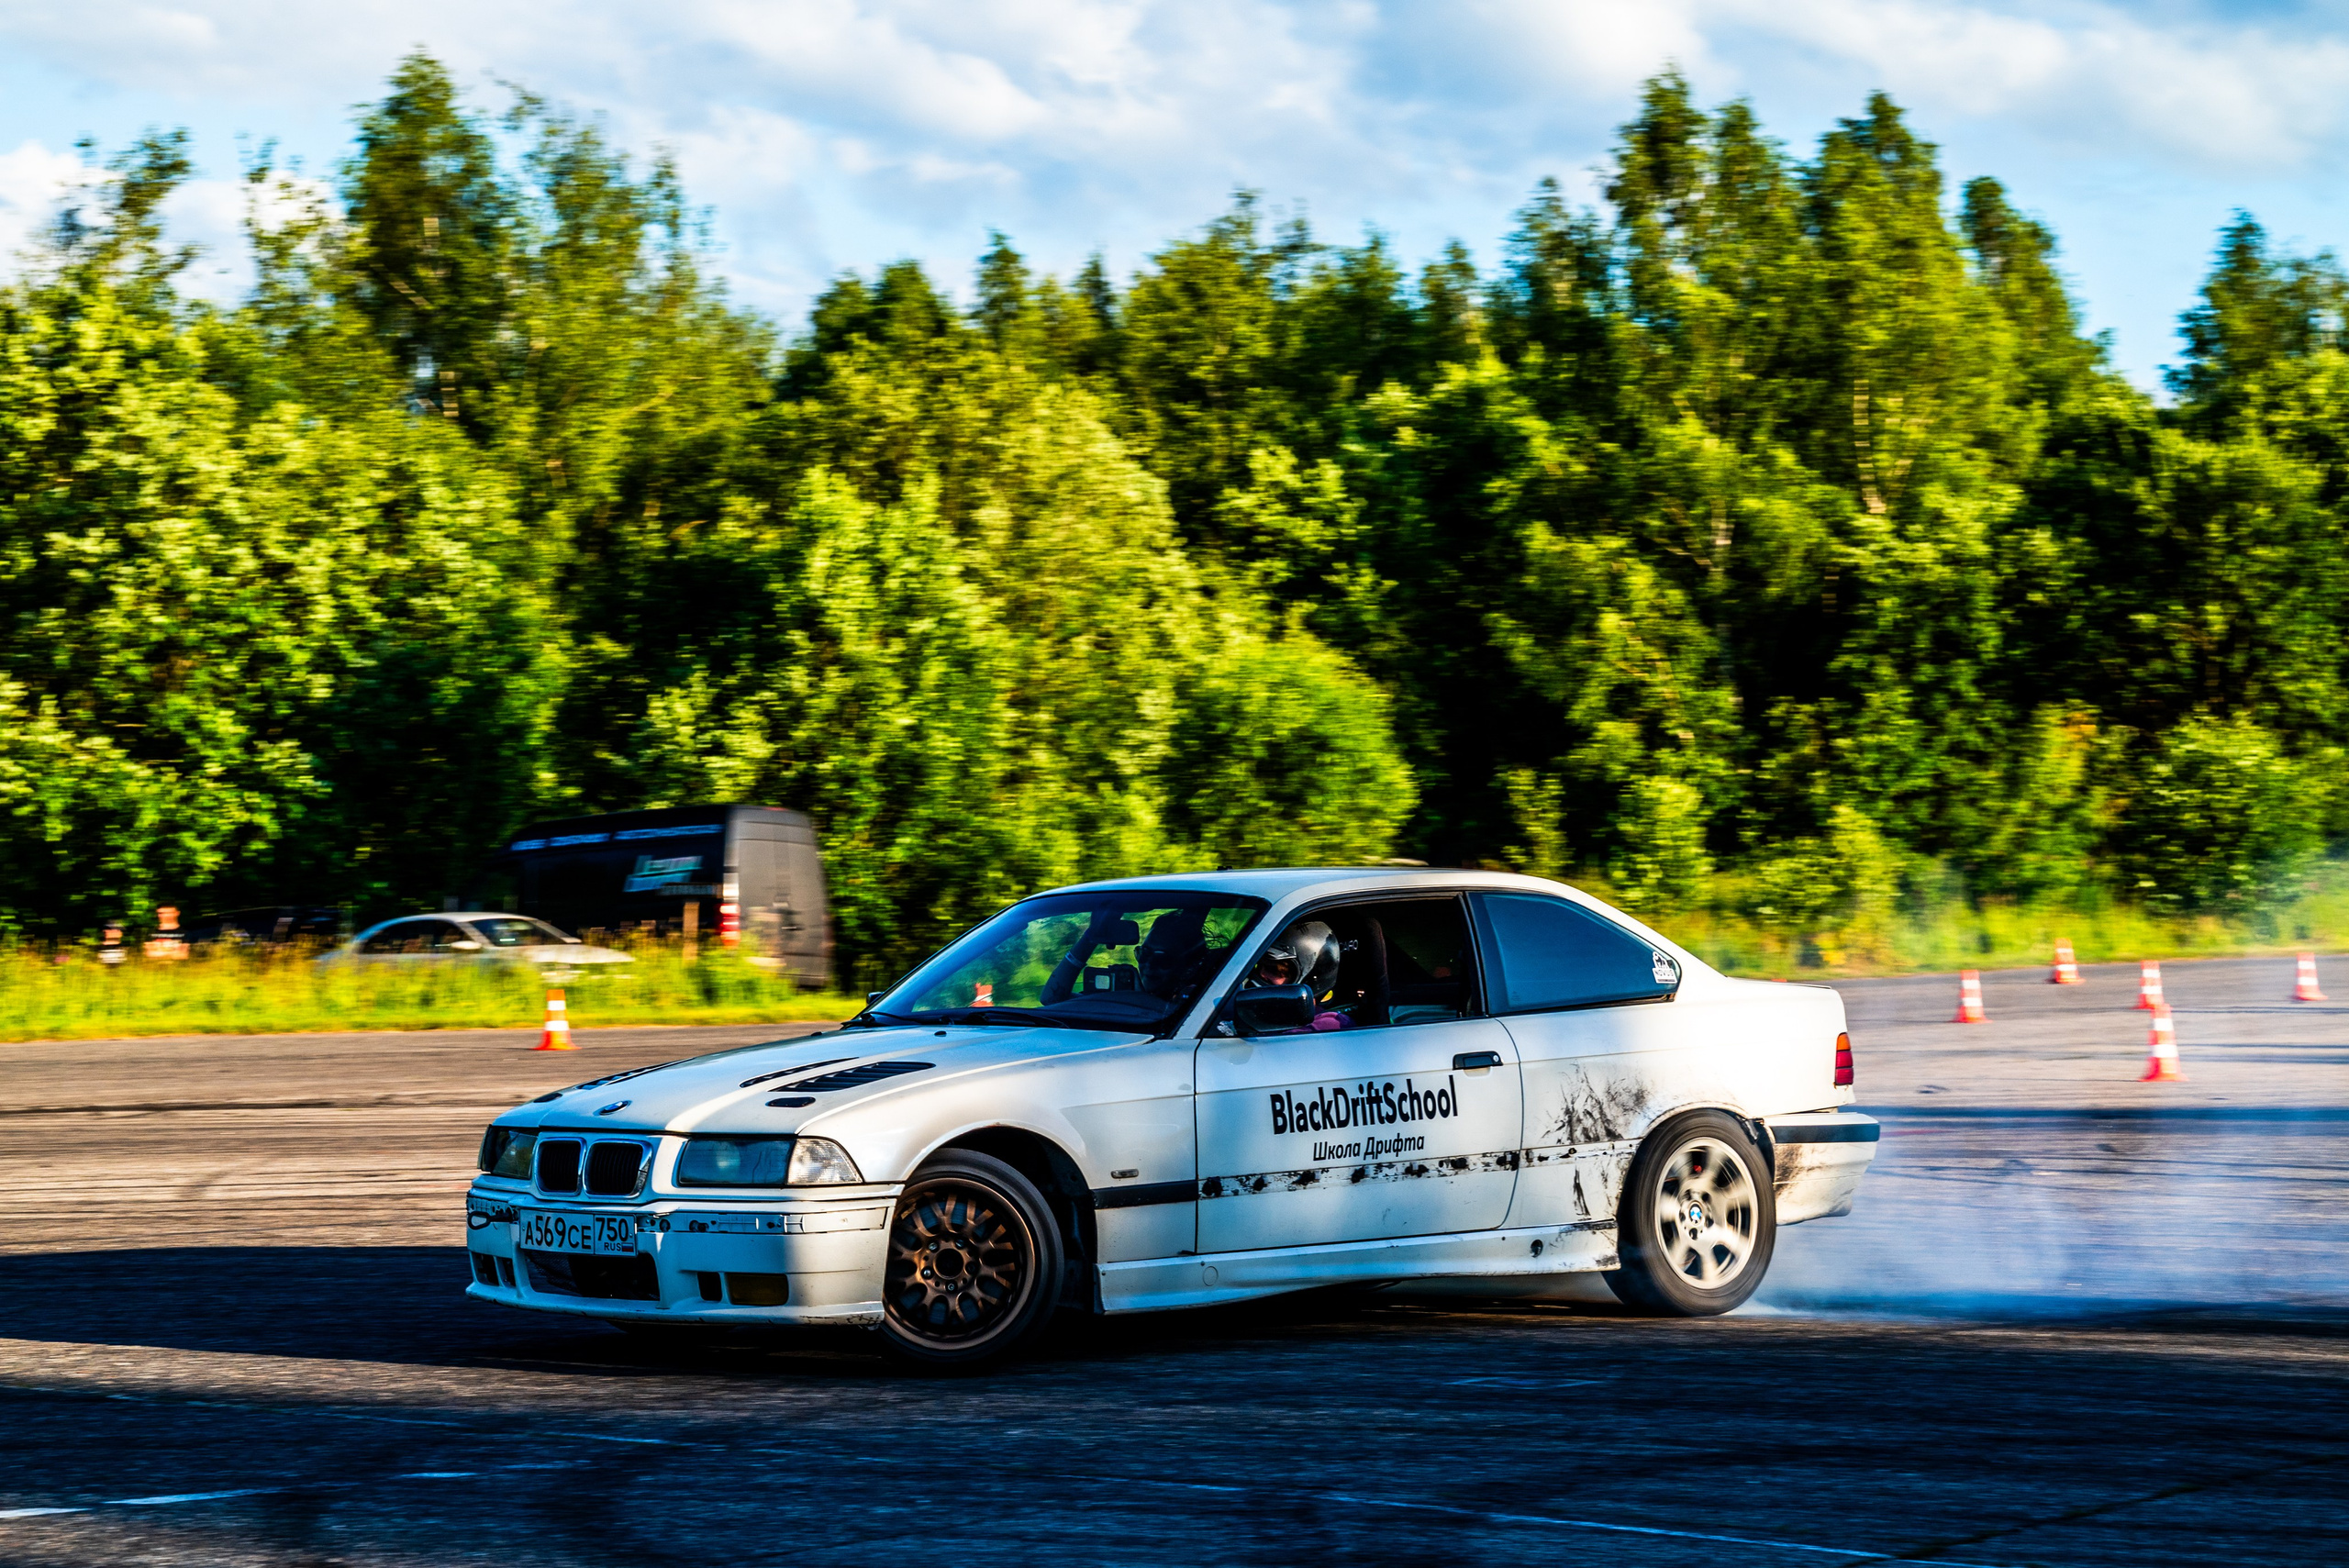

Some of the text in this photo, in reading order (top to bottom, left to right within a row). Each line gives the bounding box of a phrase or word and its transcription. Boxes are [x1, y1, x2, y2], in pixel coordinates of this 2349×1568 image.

[1270, 1074, 1458, 1135] BlackDriftSchool
[1313, 1132, 1425, 1161] Школа Дрифта
[596, 1217, 629, 1242] 750
[604, 1242, 621, 1251] RUS
